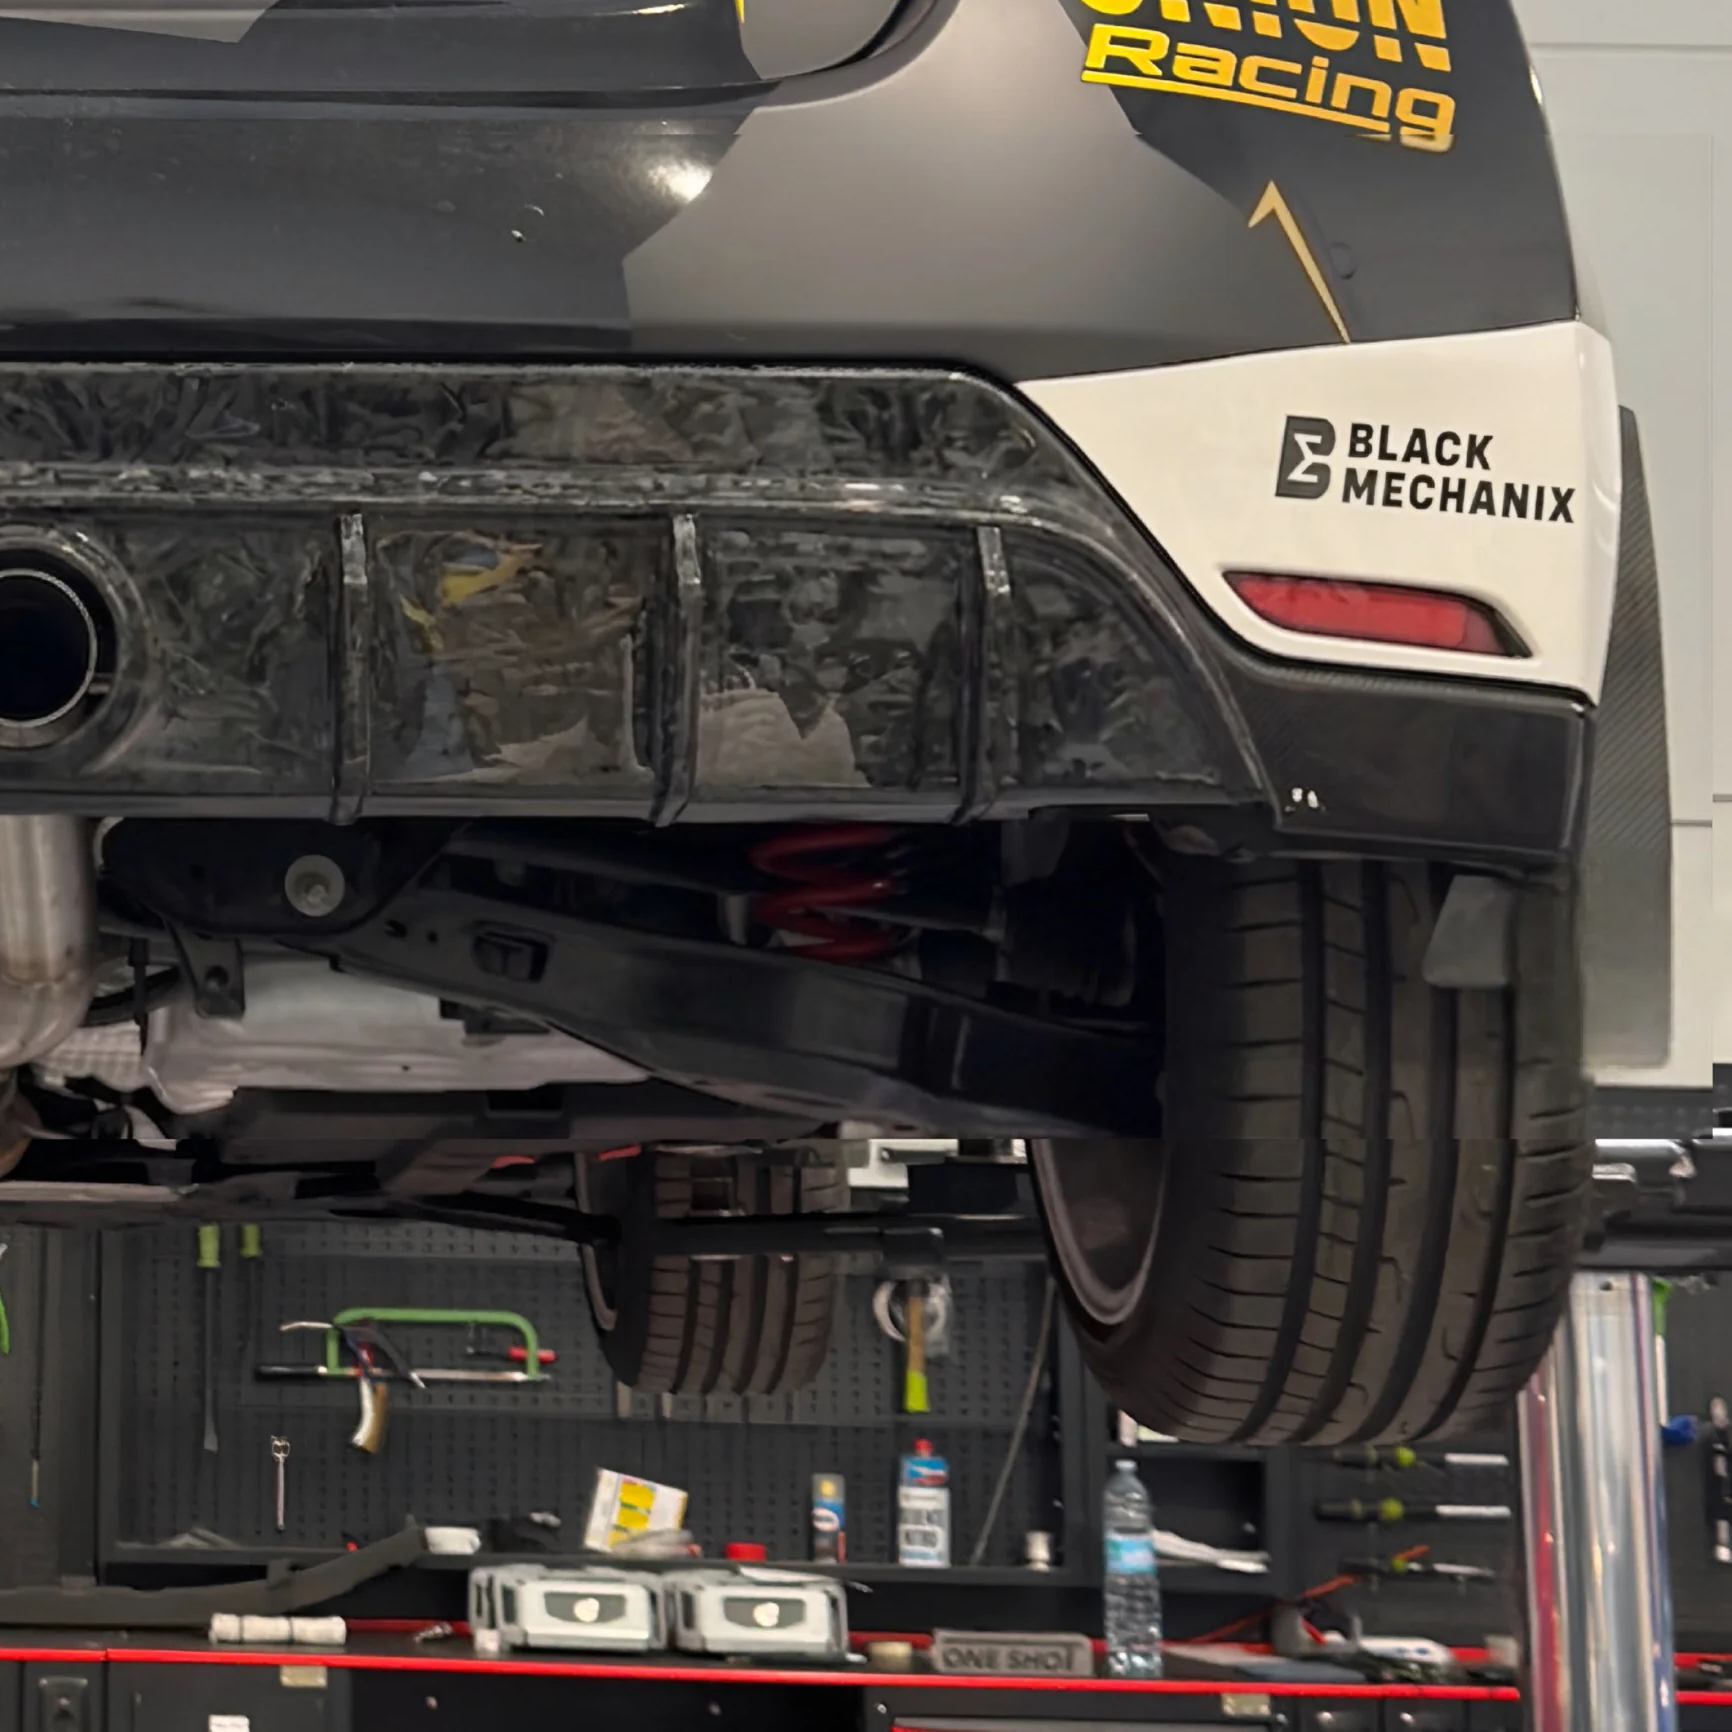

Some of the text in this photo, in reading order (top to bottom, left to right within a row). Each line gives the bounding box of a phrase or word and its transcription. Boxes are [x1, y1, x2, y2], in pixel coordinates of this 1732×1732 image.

[1085, 23, 1456, 152] Racing
[1348, 422, 1493, 471] BLACK
[1342, 467, 1576, 523] MECHANIX
